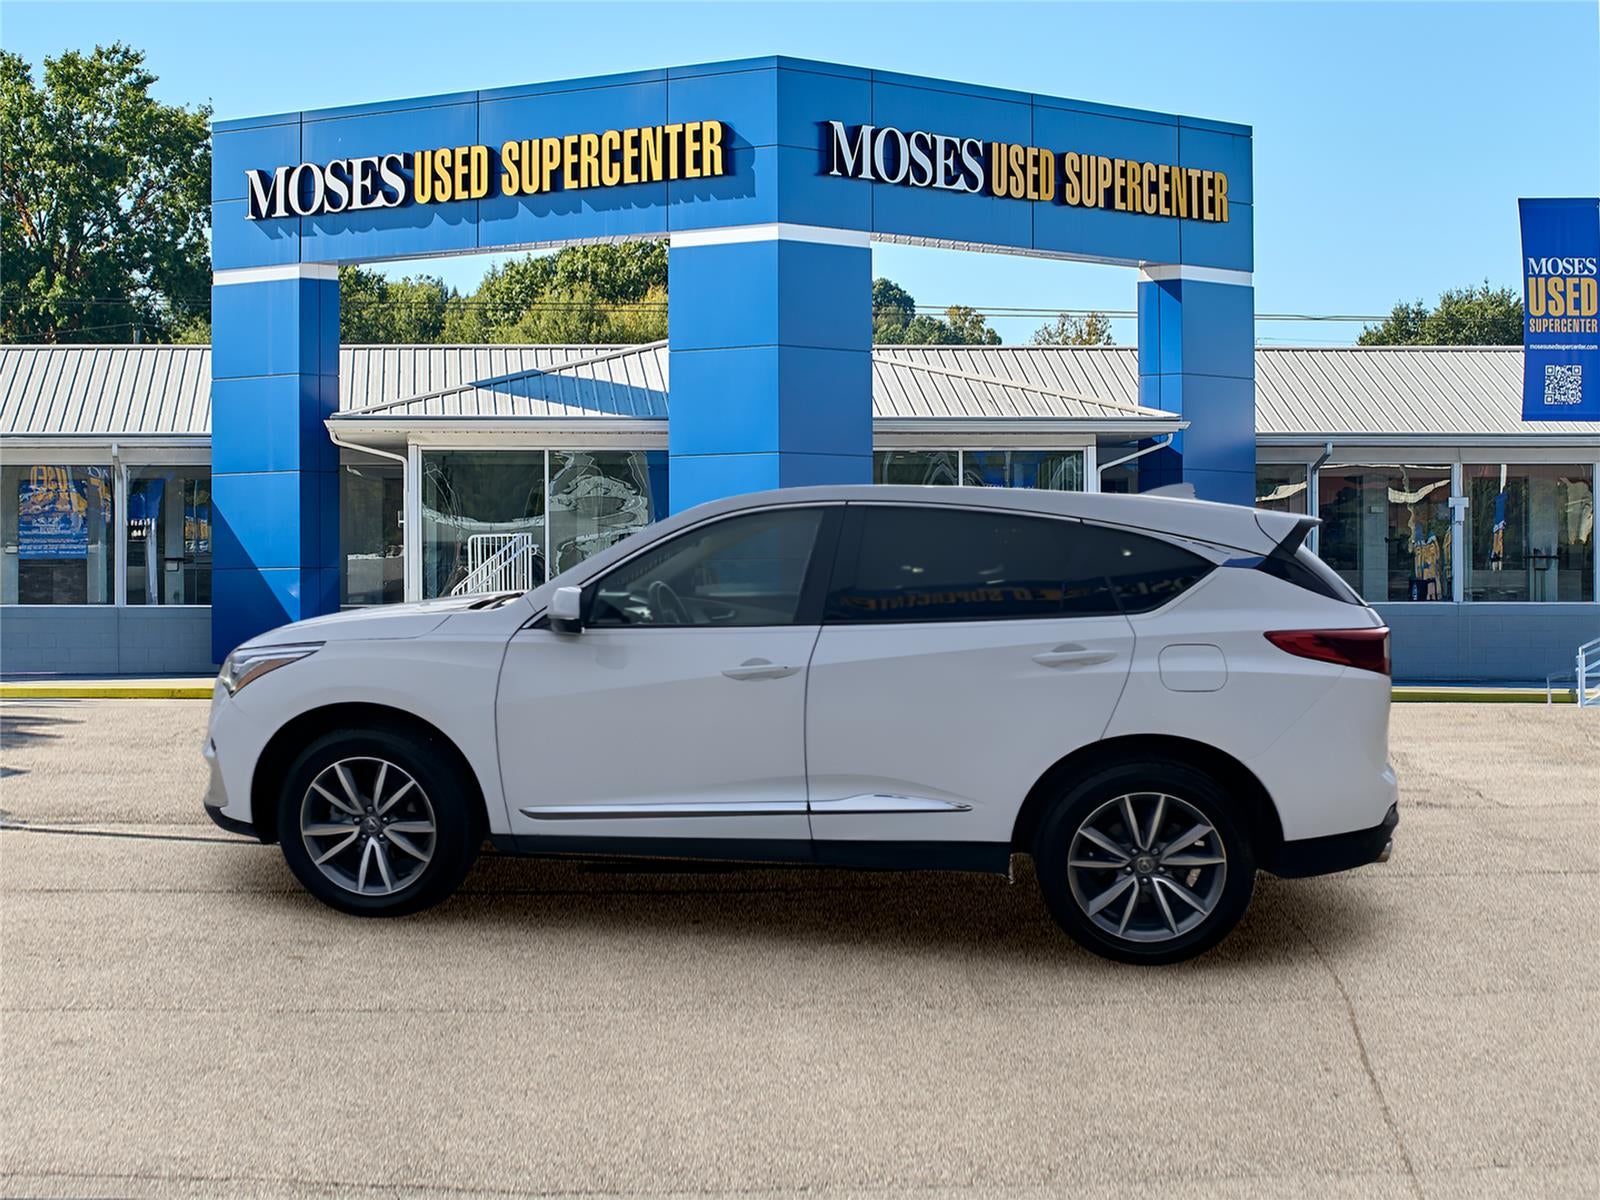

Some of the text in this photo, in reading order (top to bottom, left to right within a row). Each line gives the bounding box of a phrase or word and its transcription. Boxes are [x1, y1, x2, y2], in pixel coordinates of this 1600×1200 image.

[244, 120, 723, 220] MOSES USED SUPERCENTER
[829, 120, 1230, 223] MOSES USED SUPERCENTER
[1527, 257, 1597, 276] MOSES
[1528, 276, 1598, 317] USED
[1529, 318, 1598, 334] SUPERCENTER
[1529, 343, 1598, 351] mosesusedsupercenter.com
